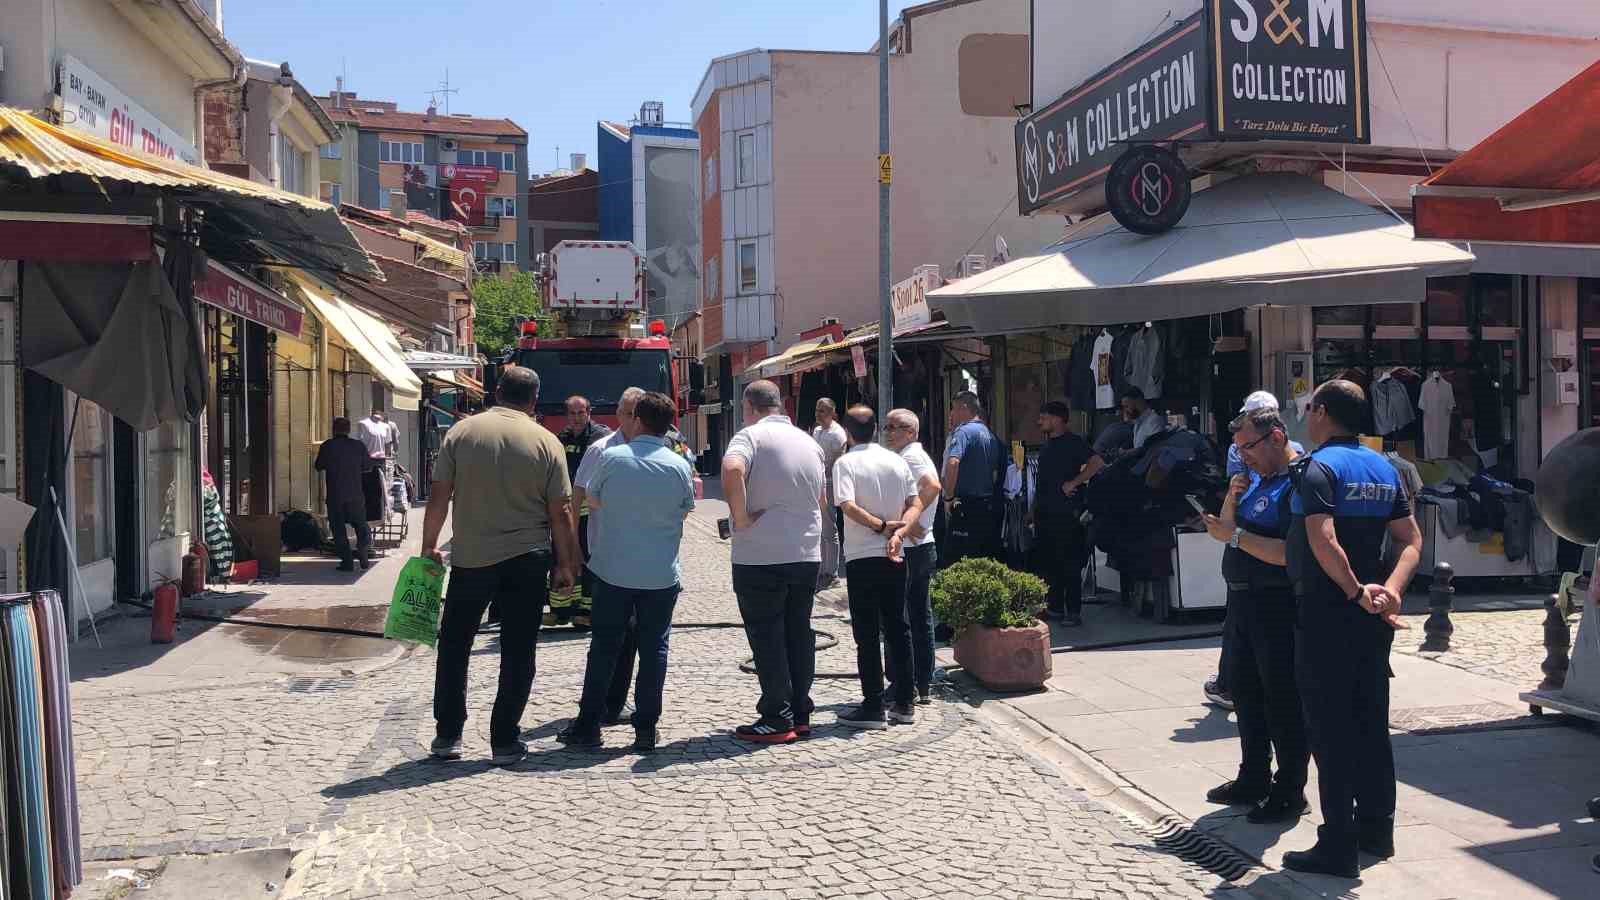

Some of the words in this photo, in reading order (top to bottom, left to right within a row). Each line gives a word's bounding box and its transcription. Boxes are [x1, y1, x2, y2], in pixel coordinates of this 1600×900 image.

[70, 73, 82, 95] BAY
[1264, 120, 1290, 131] Dolu
[1290, 121, 1308, 133] Bir
[1308, 122, 1338, 136] Hayat
[913, 277, 924, 304] 26
